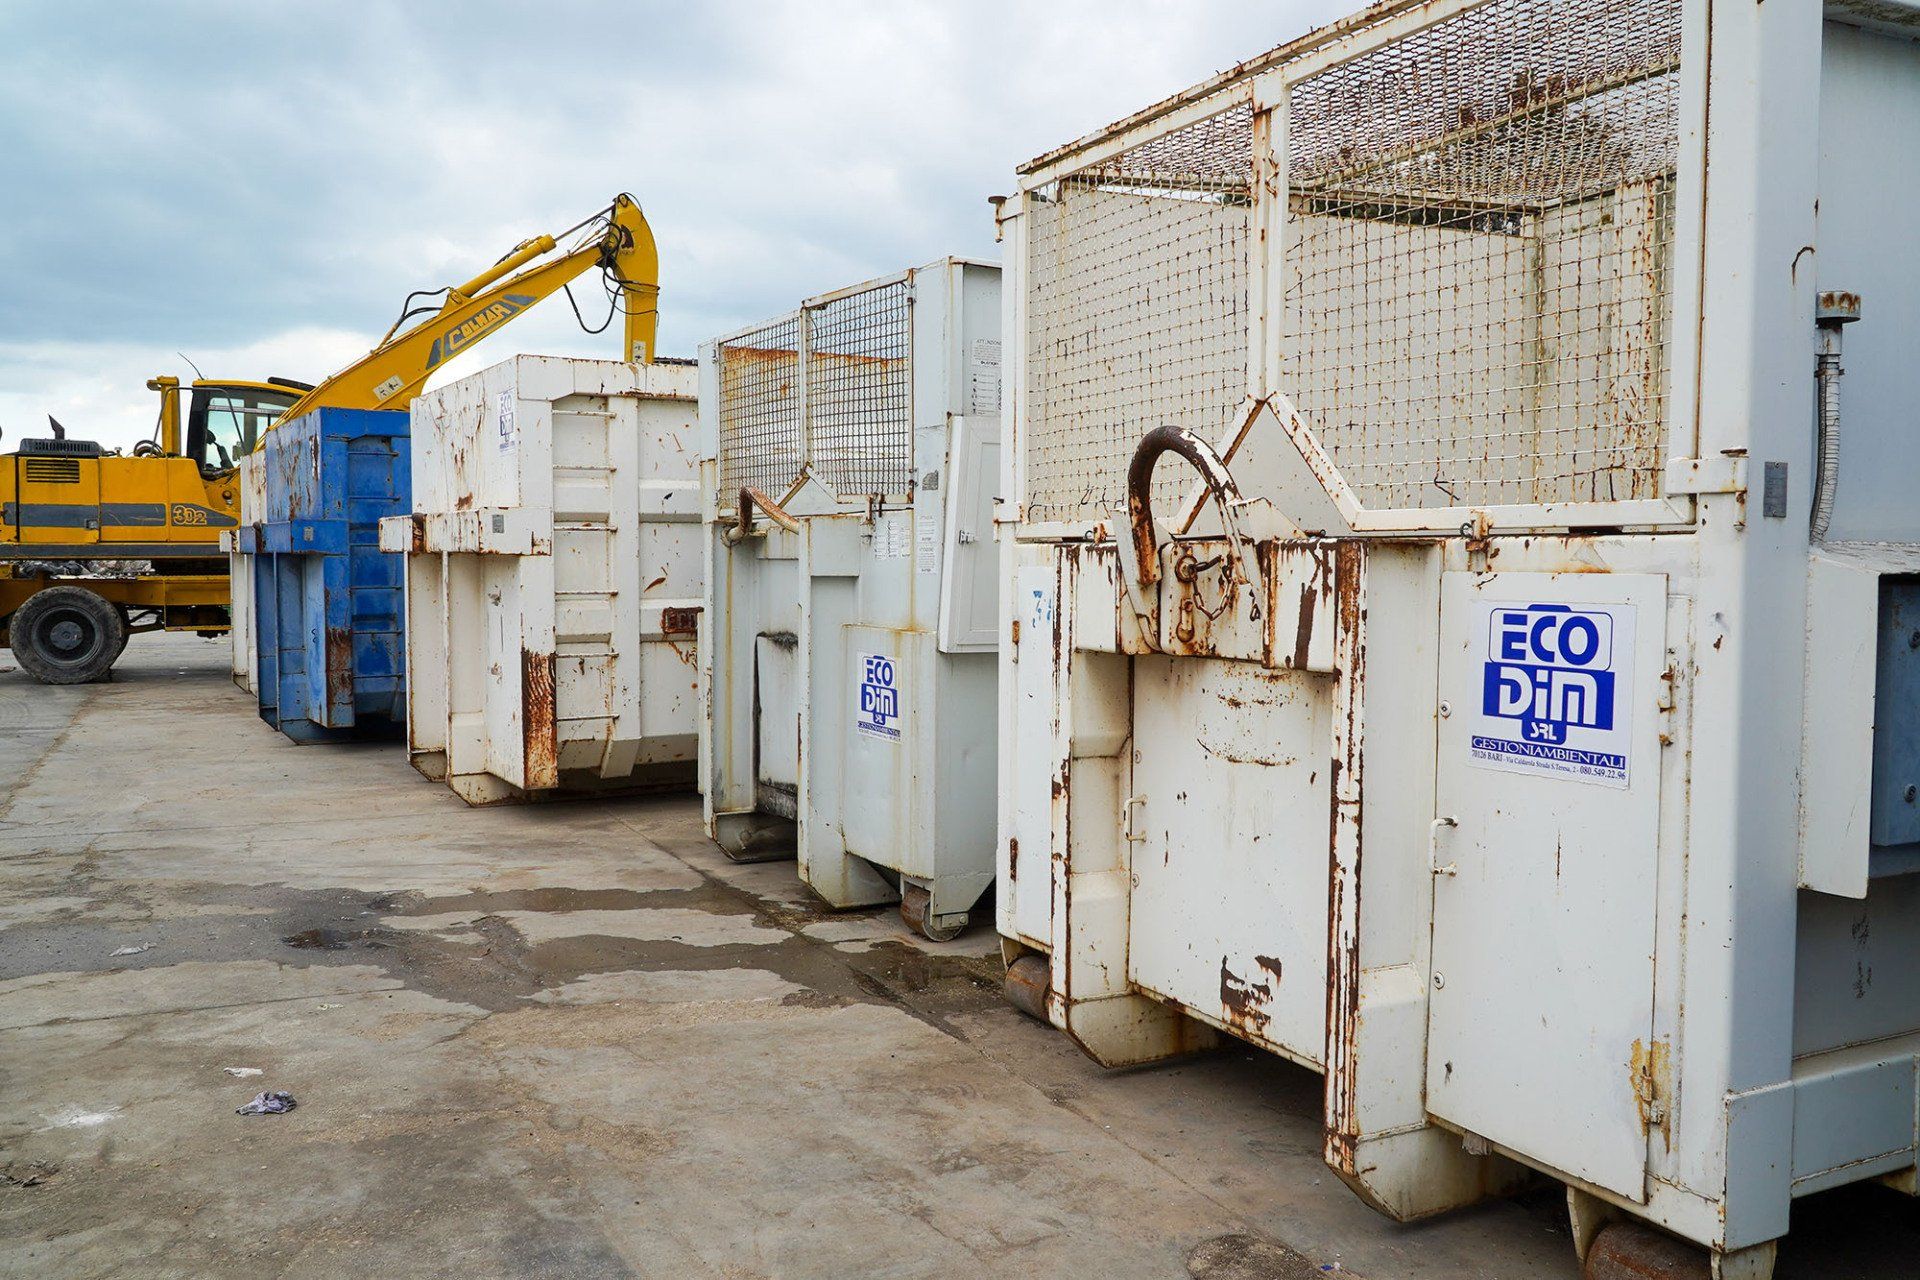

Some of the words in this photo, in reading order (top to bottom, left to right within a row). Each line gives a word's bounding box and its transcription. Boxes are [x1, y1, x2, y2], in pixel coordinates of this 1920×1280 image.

[448, 303, 512, 350] COLMAR
[173, 505, 207, 525] 302
[1501, 612, 1599, 666] ECO
[866, 659, 893, 687] ECO
[1529, 721, 1557, 740] SRL
[1471, 749, 1487, 759] 70126
[1487, 751, 1502, 761] BARI
[1506, 756, 1514, 764] Via
[1579, 765, 1626, 780] 080.549.22.96
